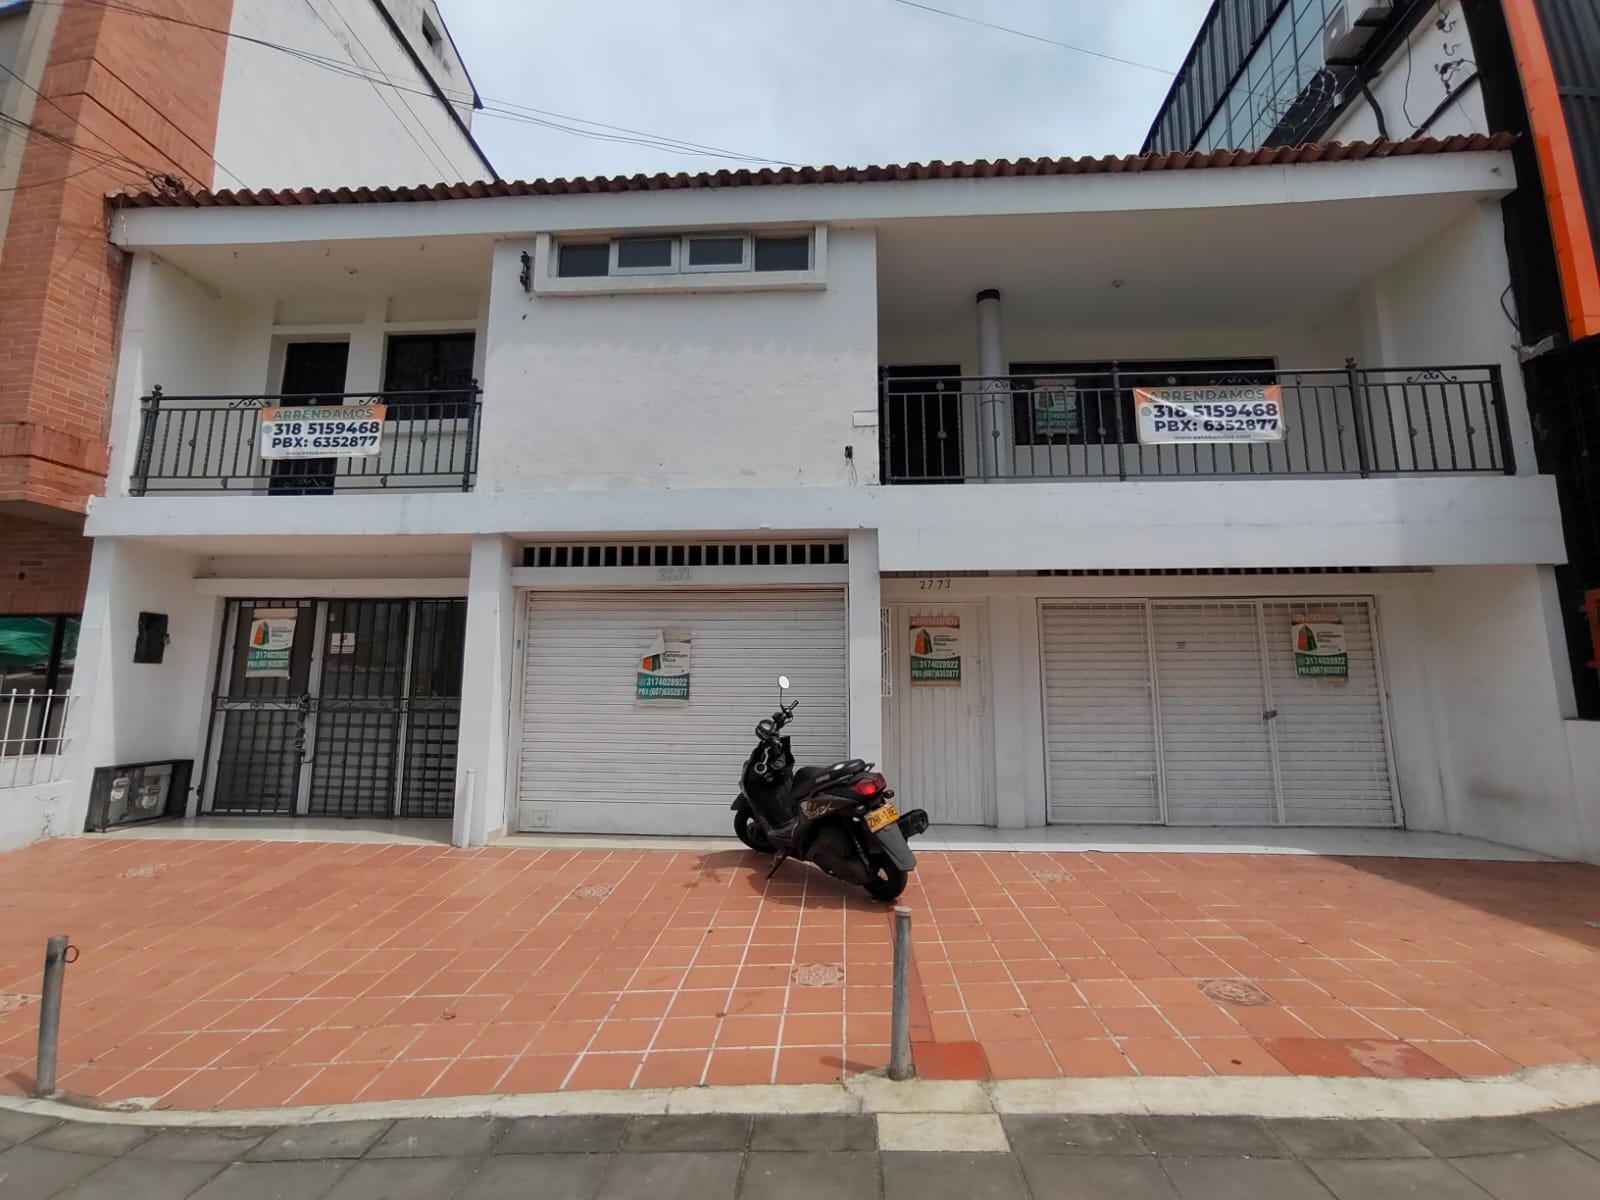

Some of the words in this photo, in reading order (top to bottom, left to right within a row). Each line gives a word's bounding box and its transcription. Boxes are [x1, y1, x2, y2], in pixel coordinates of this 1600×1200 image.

[1149, 388, 1266, 401] ARRENDAMOS
[272, 408, 374, 420] ARRENDAMOS
[1153, 404, 1188, 418] 318
[1193, 403, 1278, 418] 5159468
[273, 422, 302, 435] 318
[307, 421, 380, 435] 5159468
[1154, 420, 1198, 432] PBX:
[1203, 419, 1279, 431] 6352877
[271, 437, 309, 448] PBX:
[313, 436, 378, 448] 6352877
